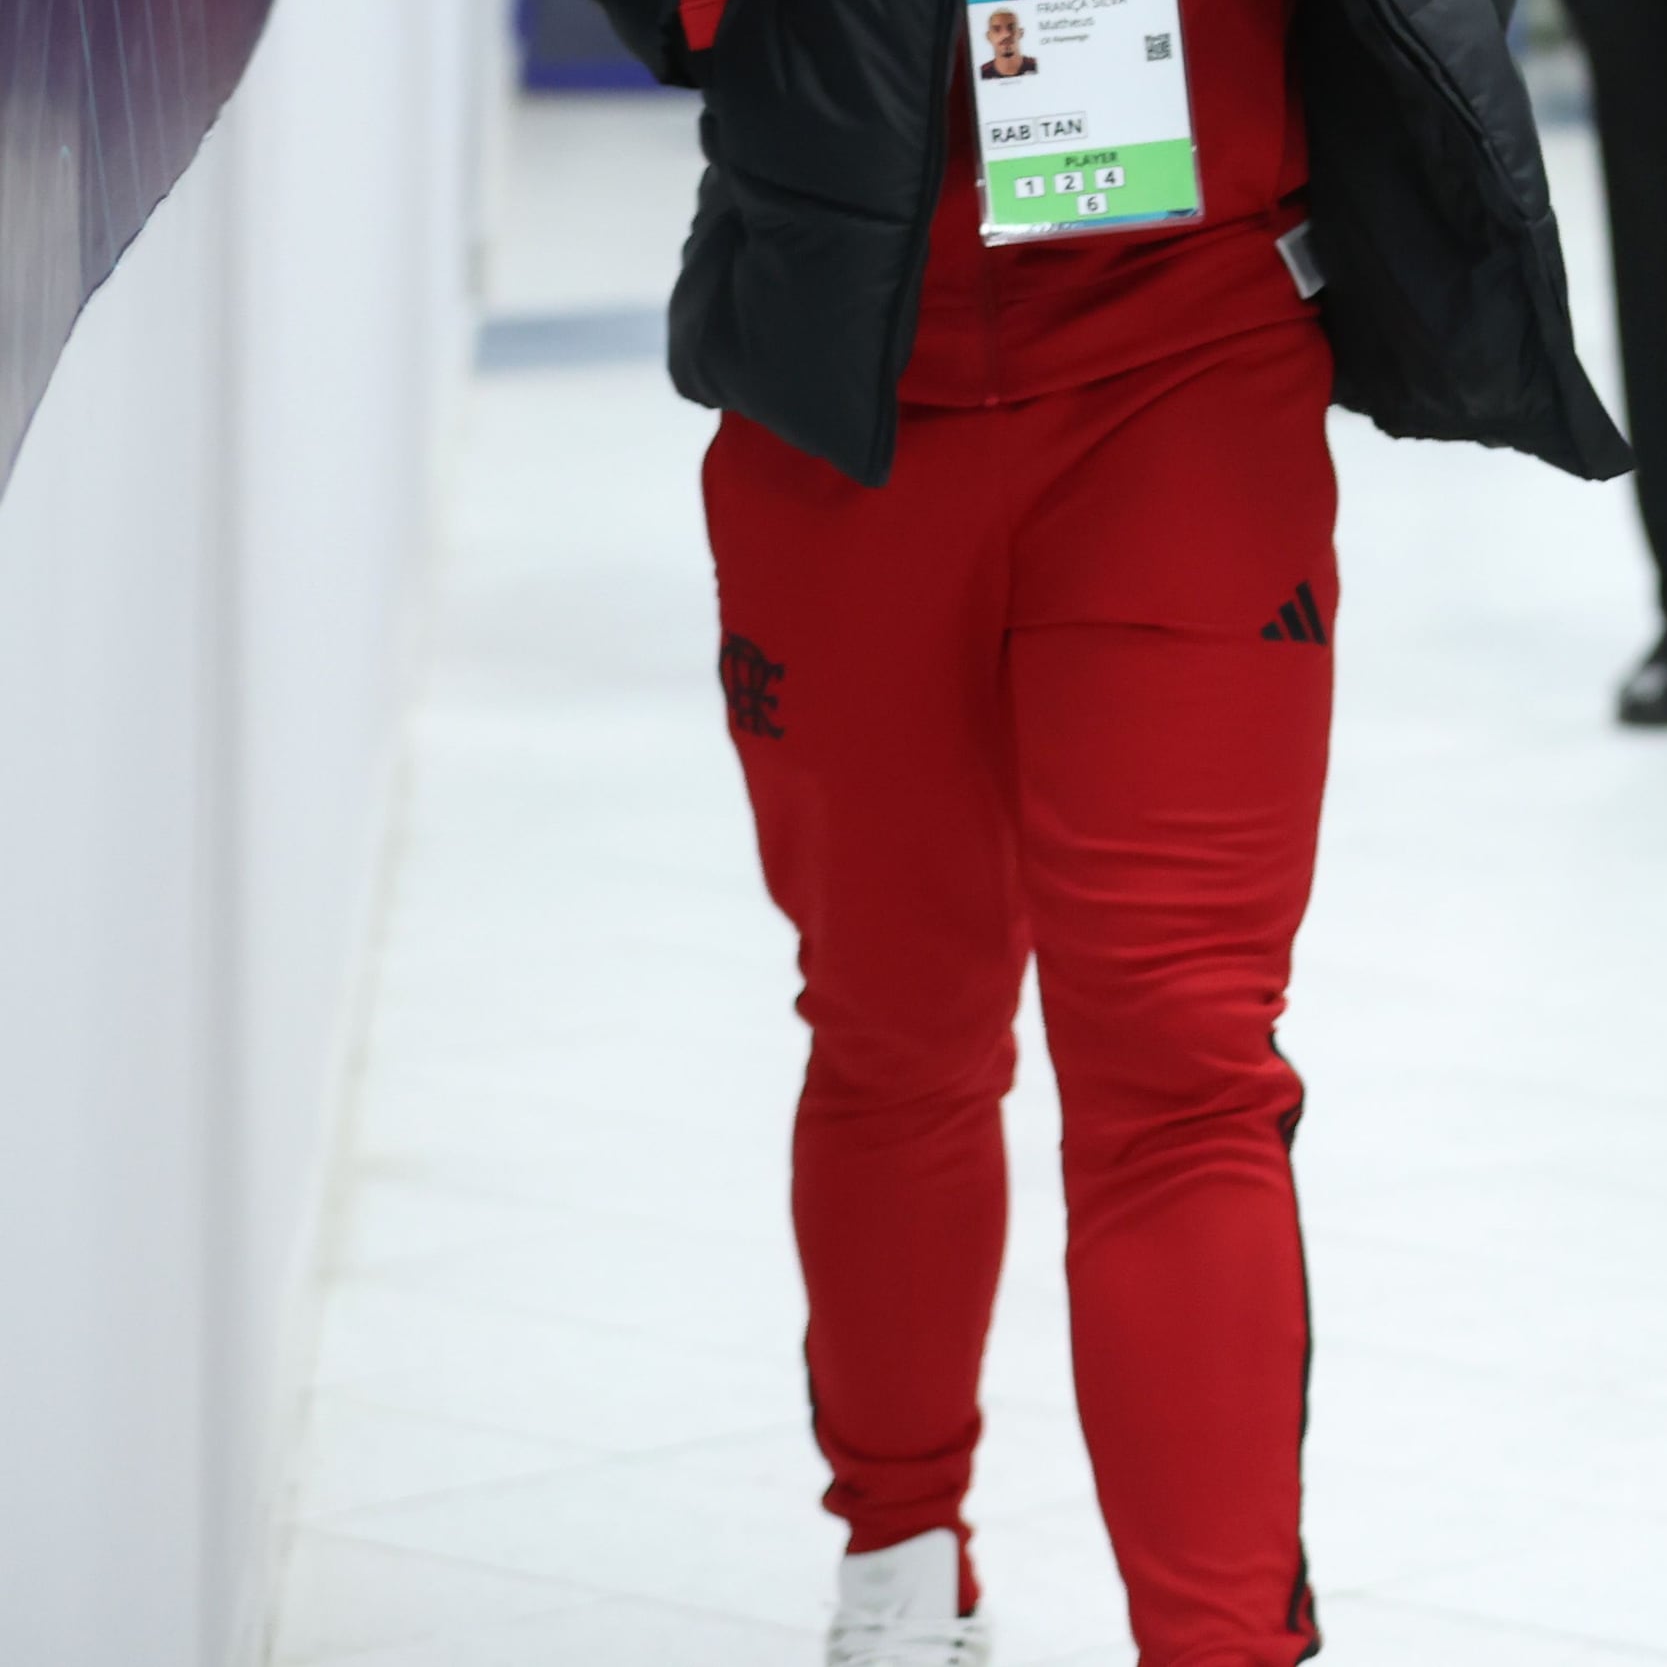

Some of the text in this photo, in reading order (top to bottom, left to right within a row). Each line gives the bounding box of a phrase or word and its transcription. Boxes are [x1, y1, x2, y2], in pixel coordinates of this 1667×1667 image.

[991, 118, 1082, 143] RAB TAN
[1064, 151, 1118, 167] PLAYER
[1064, 175, 1075, 190] 2
[1104, 170, 1116, 184] 4
[1086, 196, 1098, 211] 6
